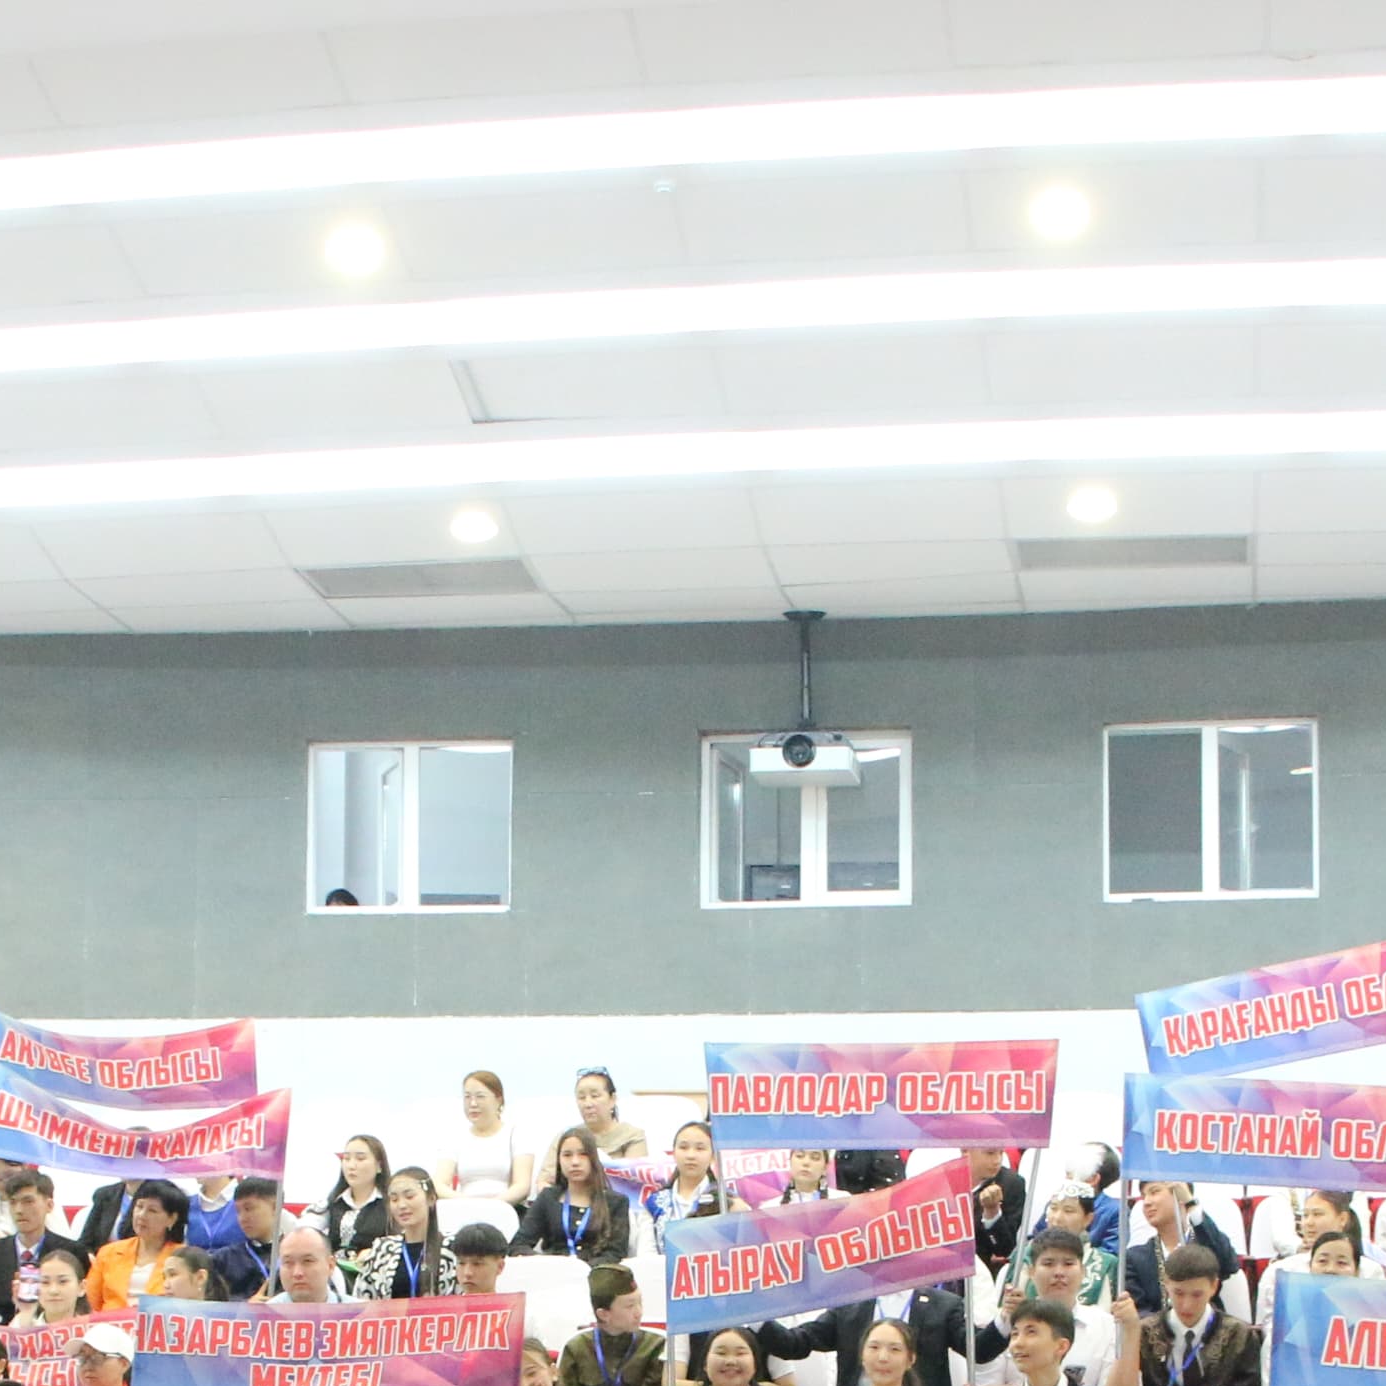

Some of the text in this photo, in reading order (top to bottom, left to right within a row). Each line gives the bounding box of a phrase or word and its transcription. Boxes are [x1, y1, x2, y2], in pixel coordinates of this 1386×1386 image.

[1162, 982, 1338, 1057] ҚАРАҒАНДЫ
[97, 1047, 221, 1090] ОБЛЫСЫ
[709, 1070, 1047, 1117] ПАВЛОДАР ОБЛЫСЫ
[148, 1113, 264, 1161] ҚАЛАСЫ
[1154, 1108, 1322, 1159] ҚОСТАНАЙ
[672, 1193, 975, 1300] АТЫРАУ ОБЛЫСЫ
[318, 1309, 513, 1359] ЗИЯТКЕРЛІК
